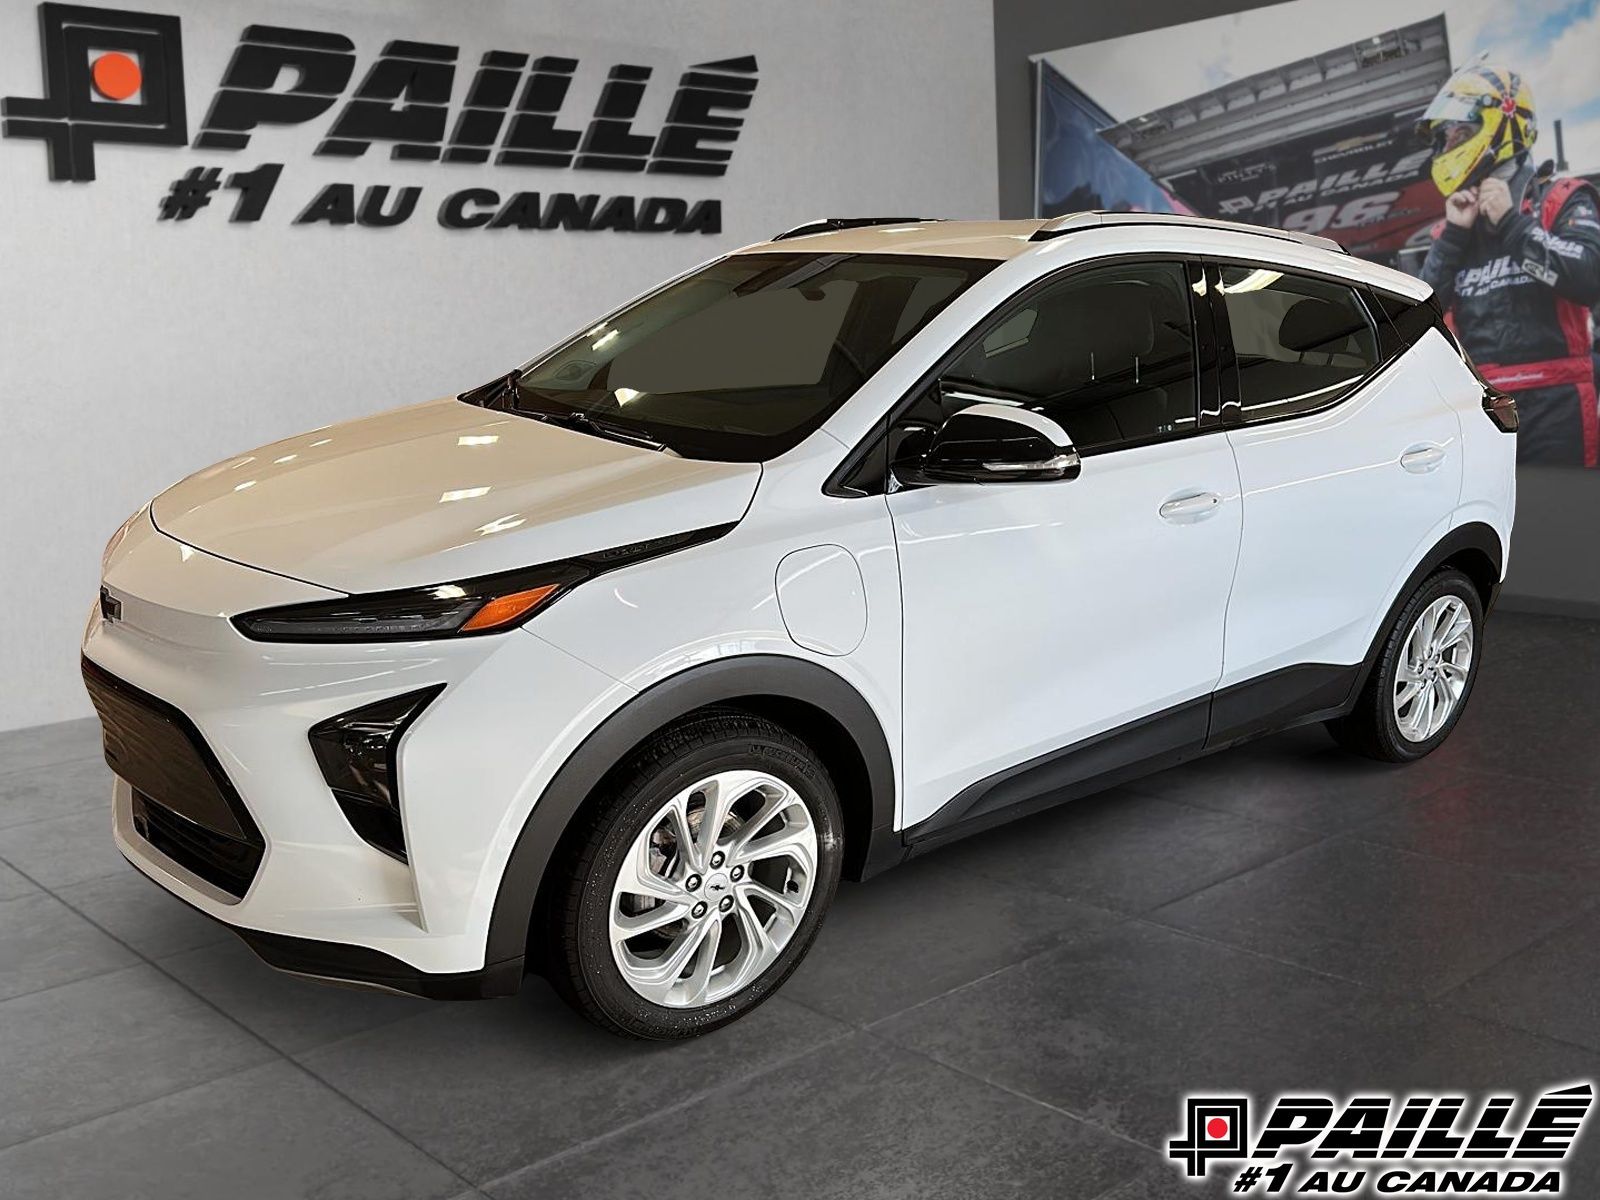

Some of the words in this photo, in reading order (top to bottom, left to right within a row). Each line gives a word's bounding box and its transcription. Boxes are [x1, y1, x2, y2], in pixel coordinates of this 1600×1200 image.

[191, 24, 759, 177] PAILLÉ
[156, 163, 285, 223] #1
[291, 183, 424, 227] AU
[437, 187, 722, 235] CANADA
[1282, 191, 1400, 234] 96
